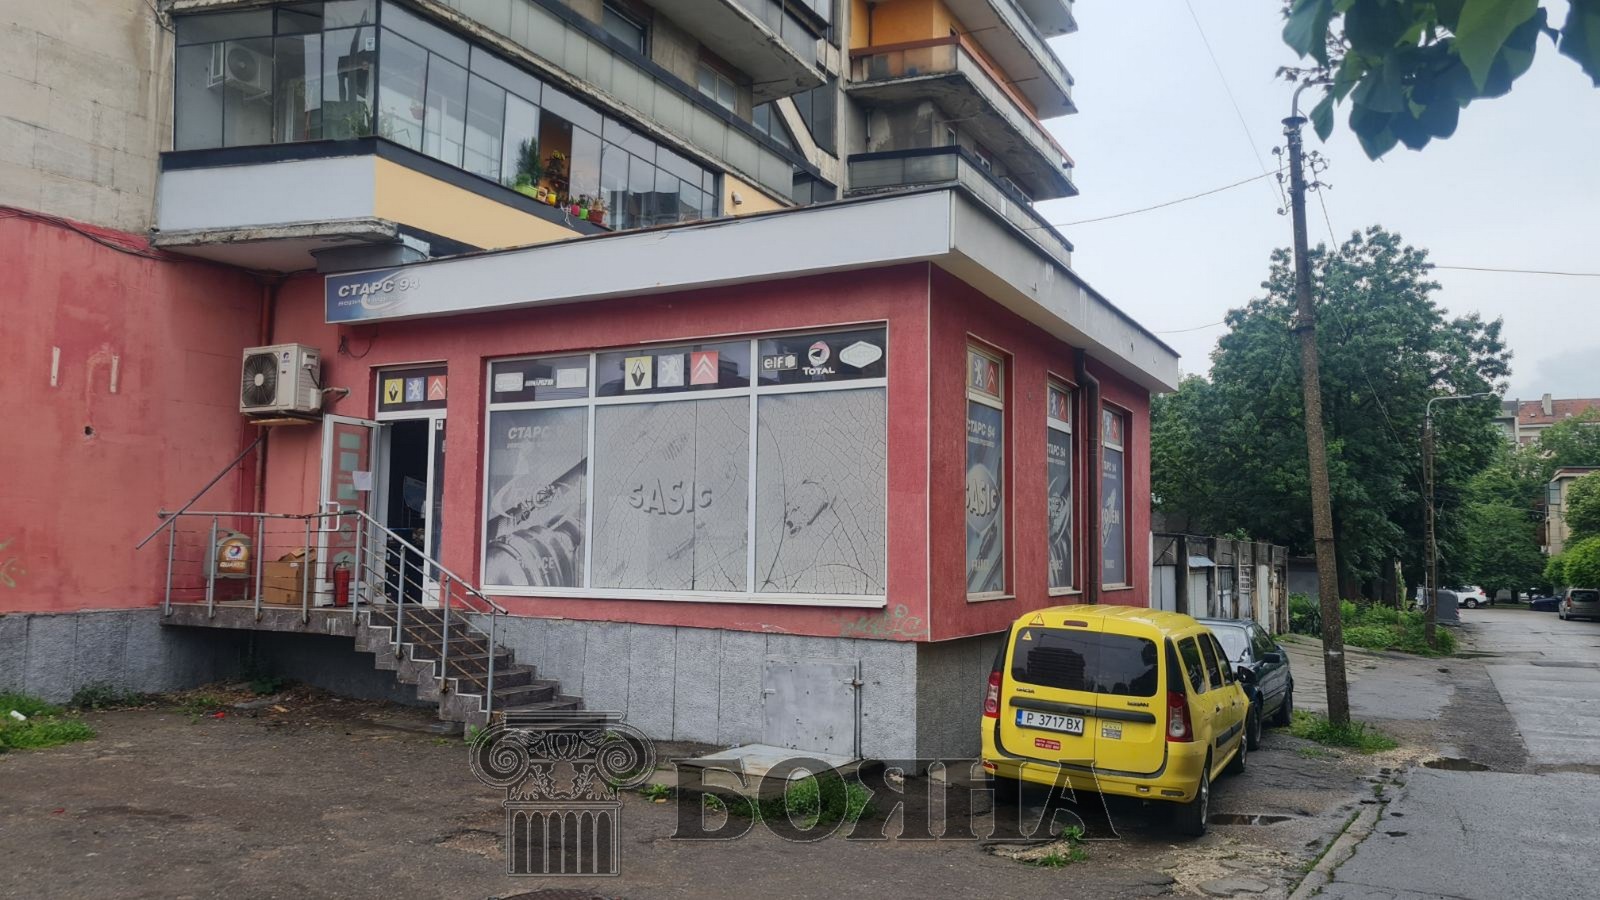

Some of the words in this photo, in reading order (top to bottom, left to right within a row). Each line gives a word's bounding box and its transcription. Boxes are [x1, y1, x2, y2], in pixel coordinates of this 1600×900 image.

[338, 280, 395, 297] СТАРС
[764, 355, 784, 369] elf
[802, 366, 835, 376] TOTAL
